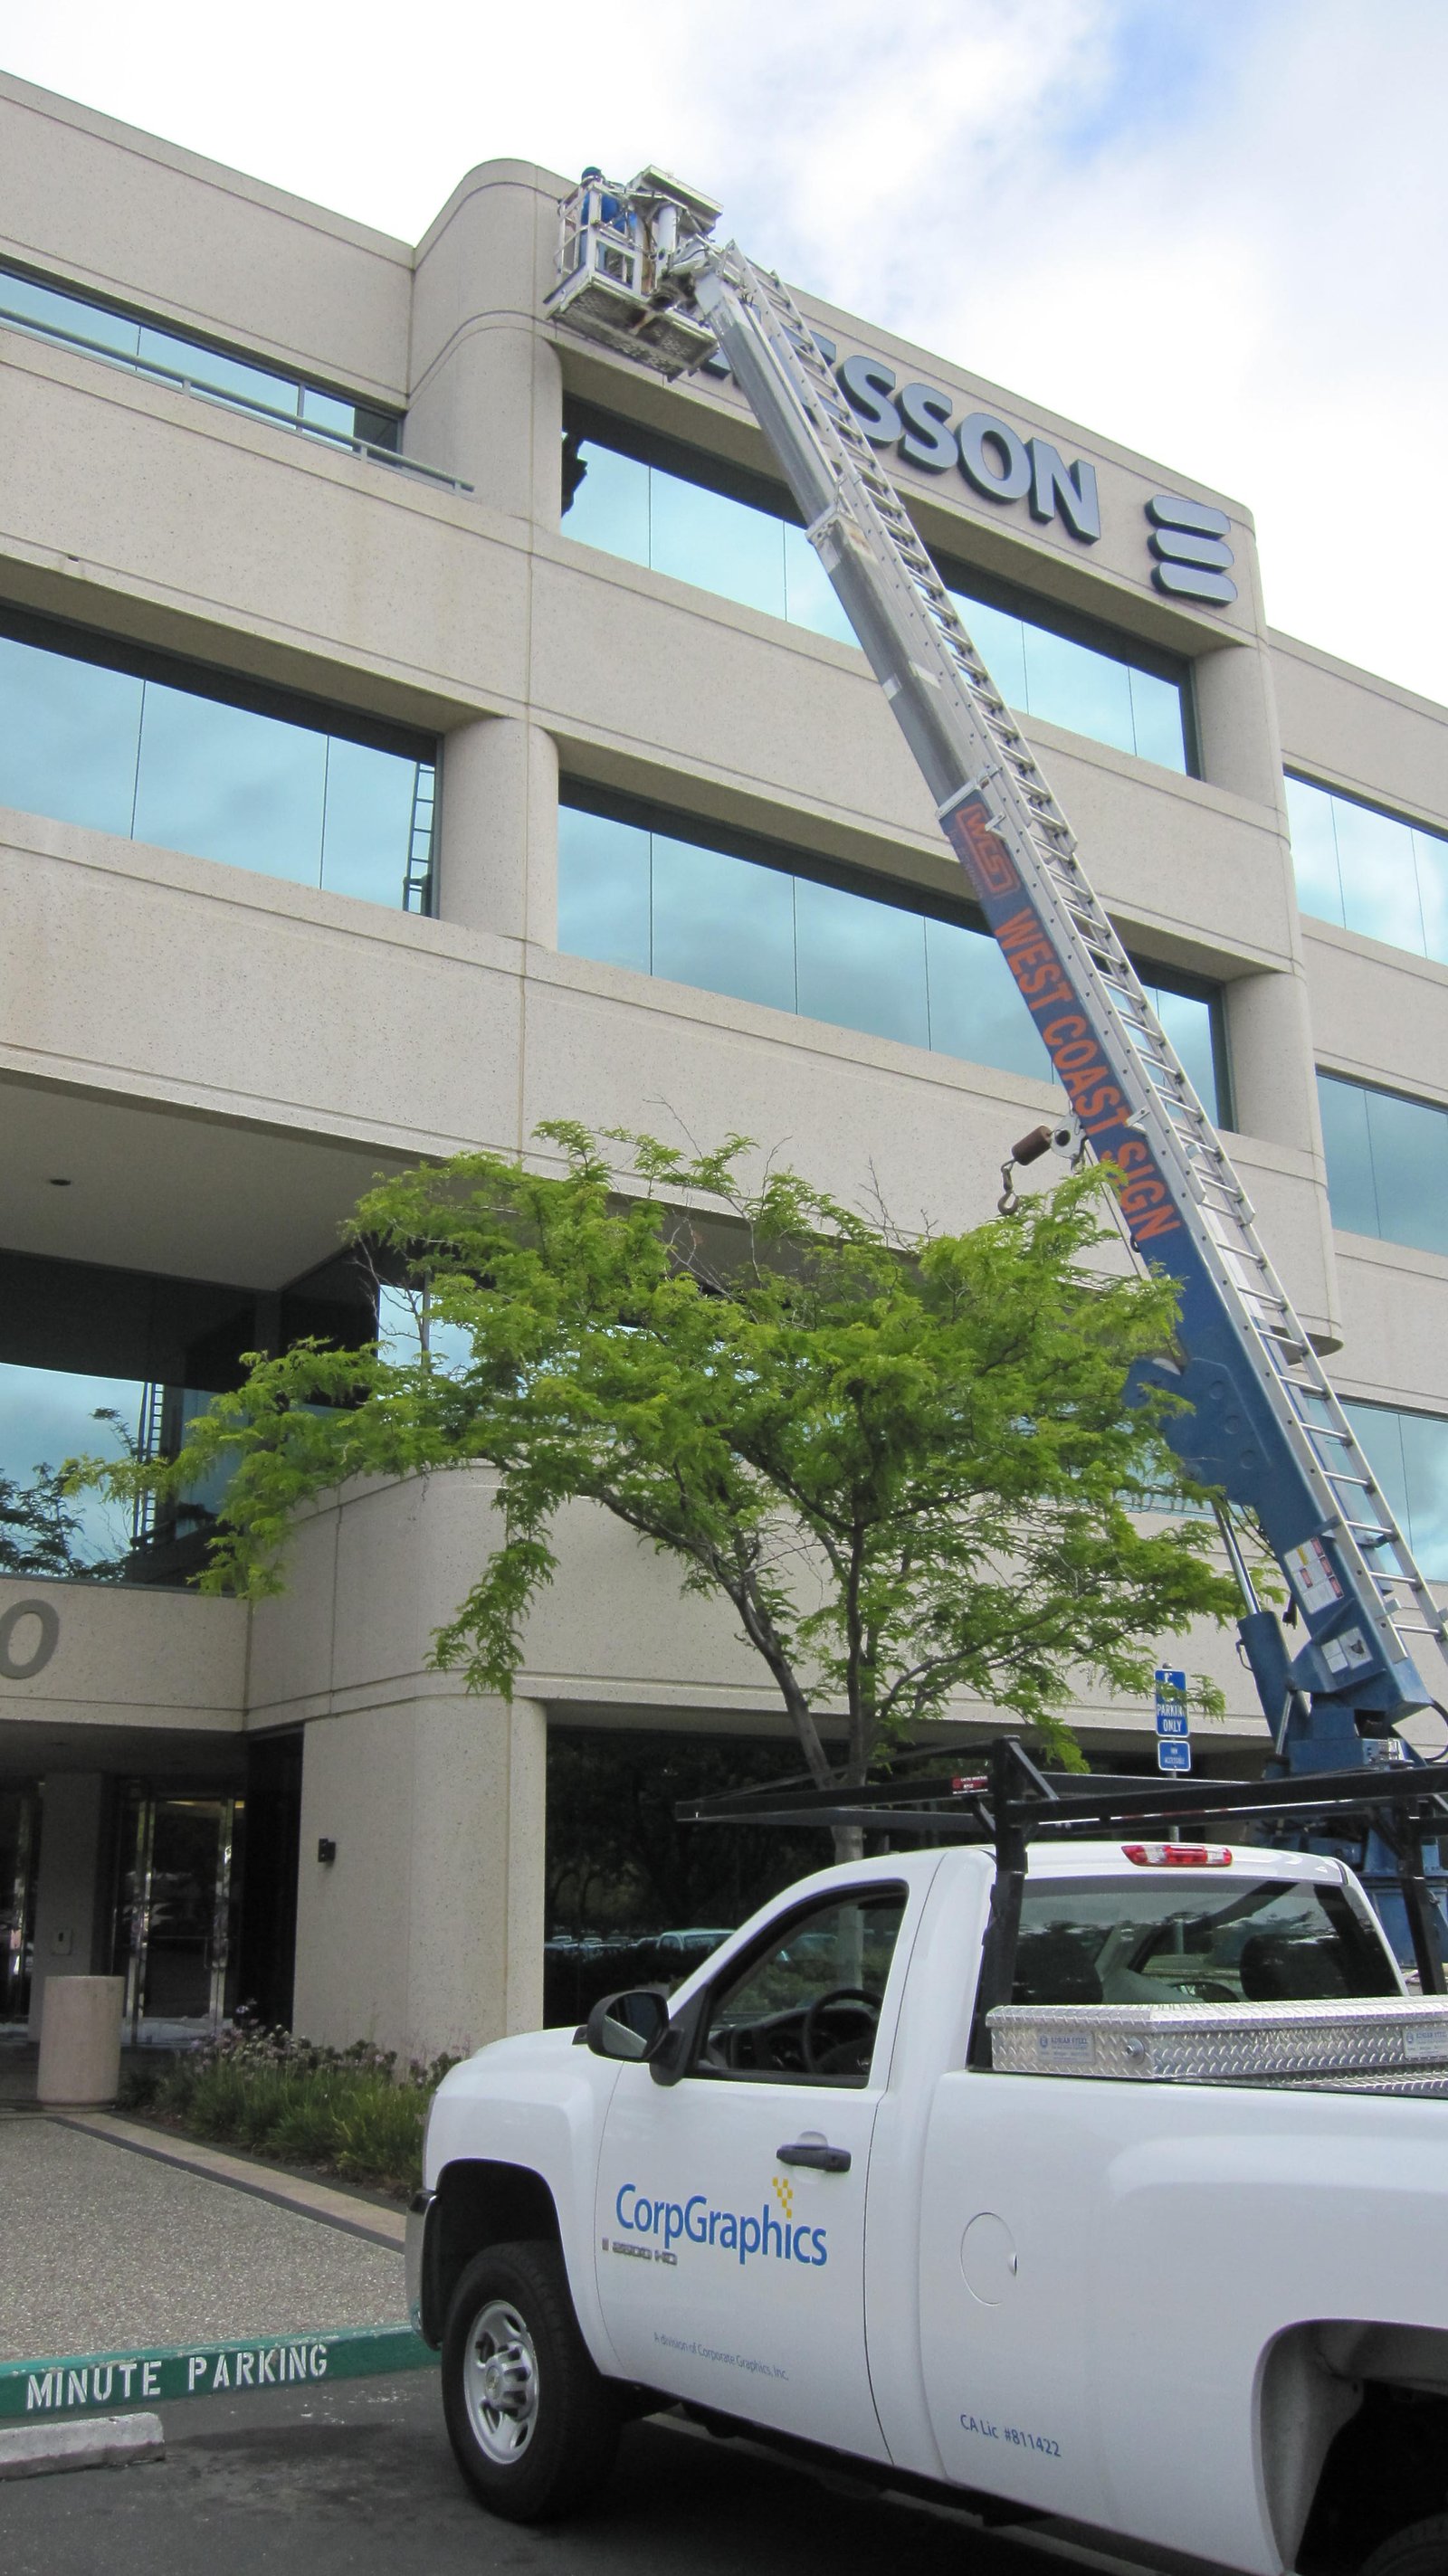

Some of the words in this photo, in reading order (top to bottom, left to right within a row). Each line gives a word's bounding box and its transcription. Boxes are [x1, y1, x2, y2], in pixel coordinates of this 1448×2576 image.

[995, 907, 1073, 1012] WEST
[1043, 1016, 1133, 1135] COAST
[1100, 1140, 1182, 1241] SIGN
[1163, 1718, 1182, 1733] ONLY
[615, 2183, 828, 2267] CorpGraphics
[660, 2334, 689, 2352] division
[697, 2343, 736, 2365] Corporate
[27, 2362, 163, 2410] MINUTE
[188, 2344, 329, 2391] PARKING
[960, 2414, 978, 2432] CA
[980, 2419, 999, 2439] Lic
[1005, 2427, 1062, 2457] #811422
